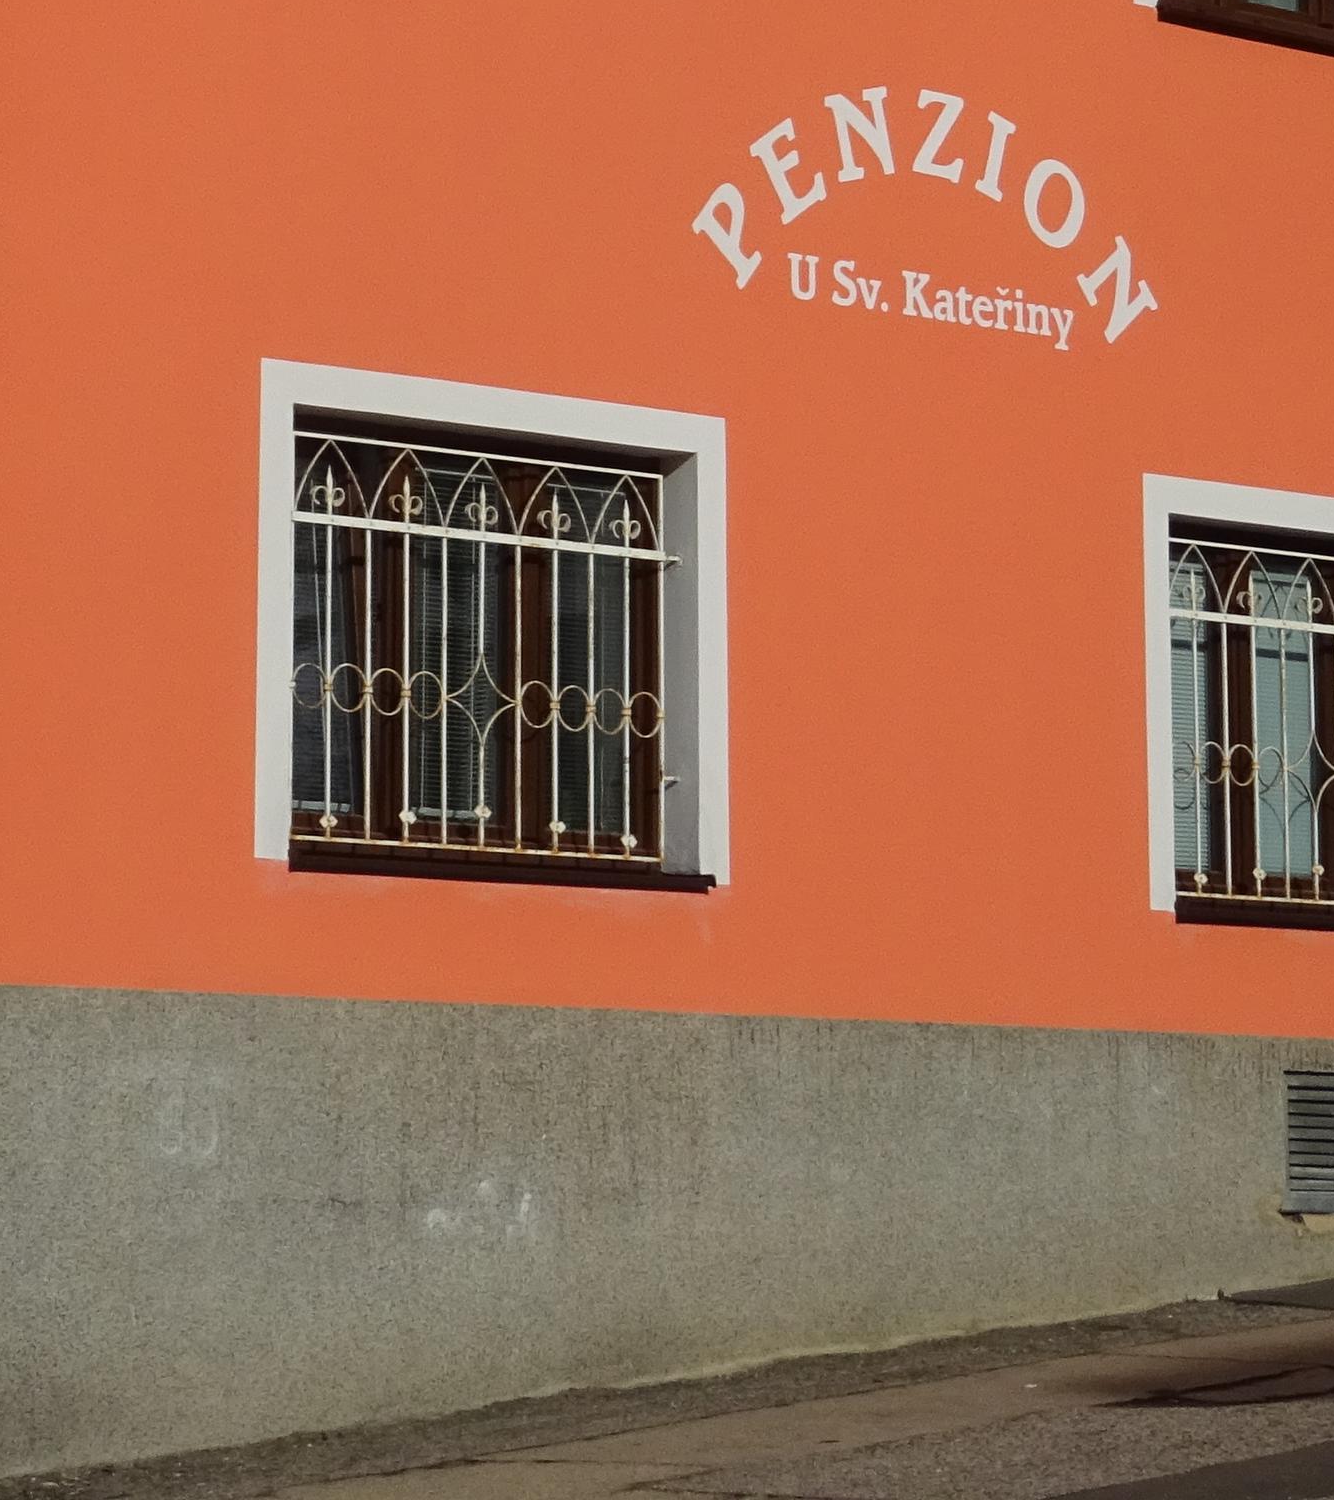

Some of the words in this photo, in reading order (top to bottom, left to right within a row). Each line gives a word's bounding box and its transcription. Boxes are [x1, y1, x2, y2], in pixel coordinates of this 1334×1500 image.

[691, 85, 1159, 344] PENZION
[787, 252, 820, 301] U
[831, 259, 889, 313] Sv.
[901, 270, 1074, 351] Kateřiny
